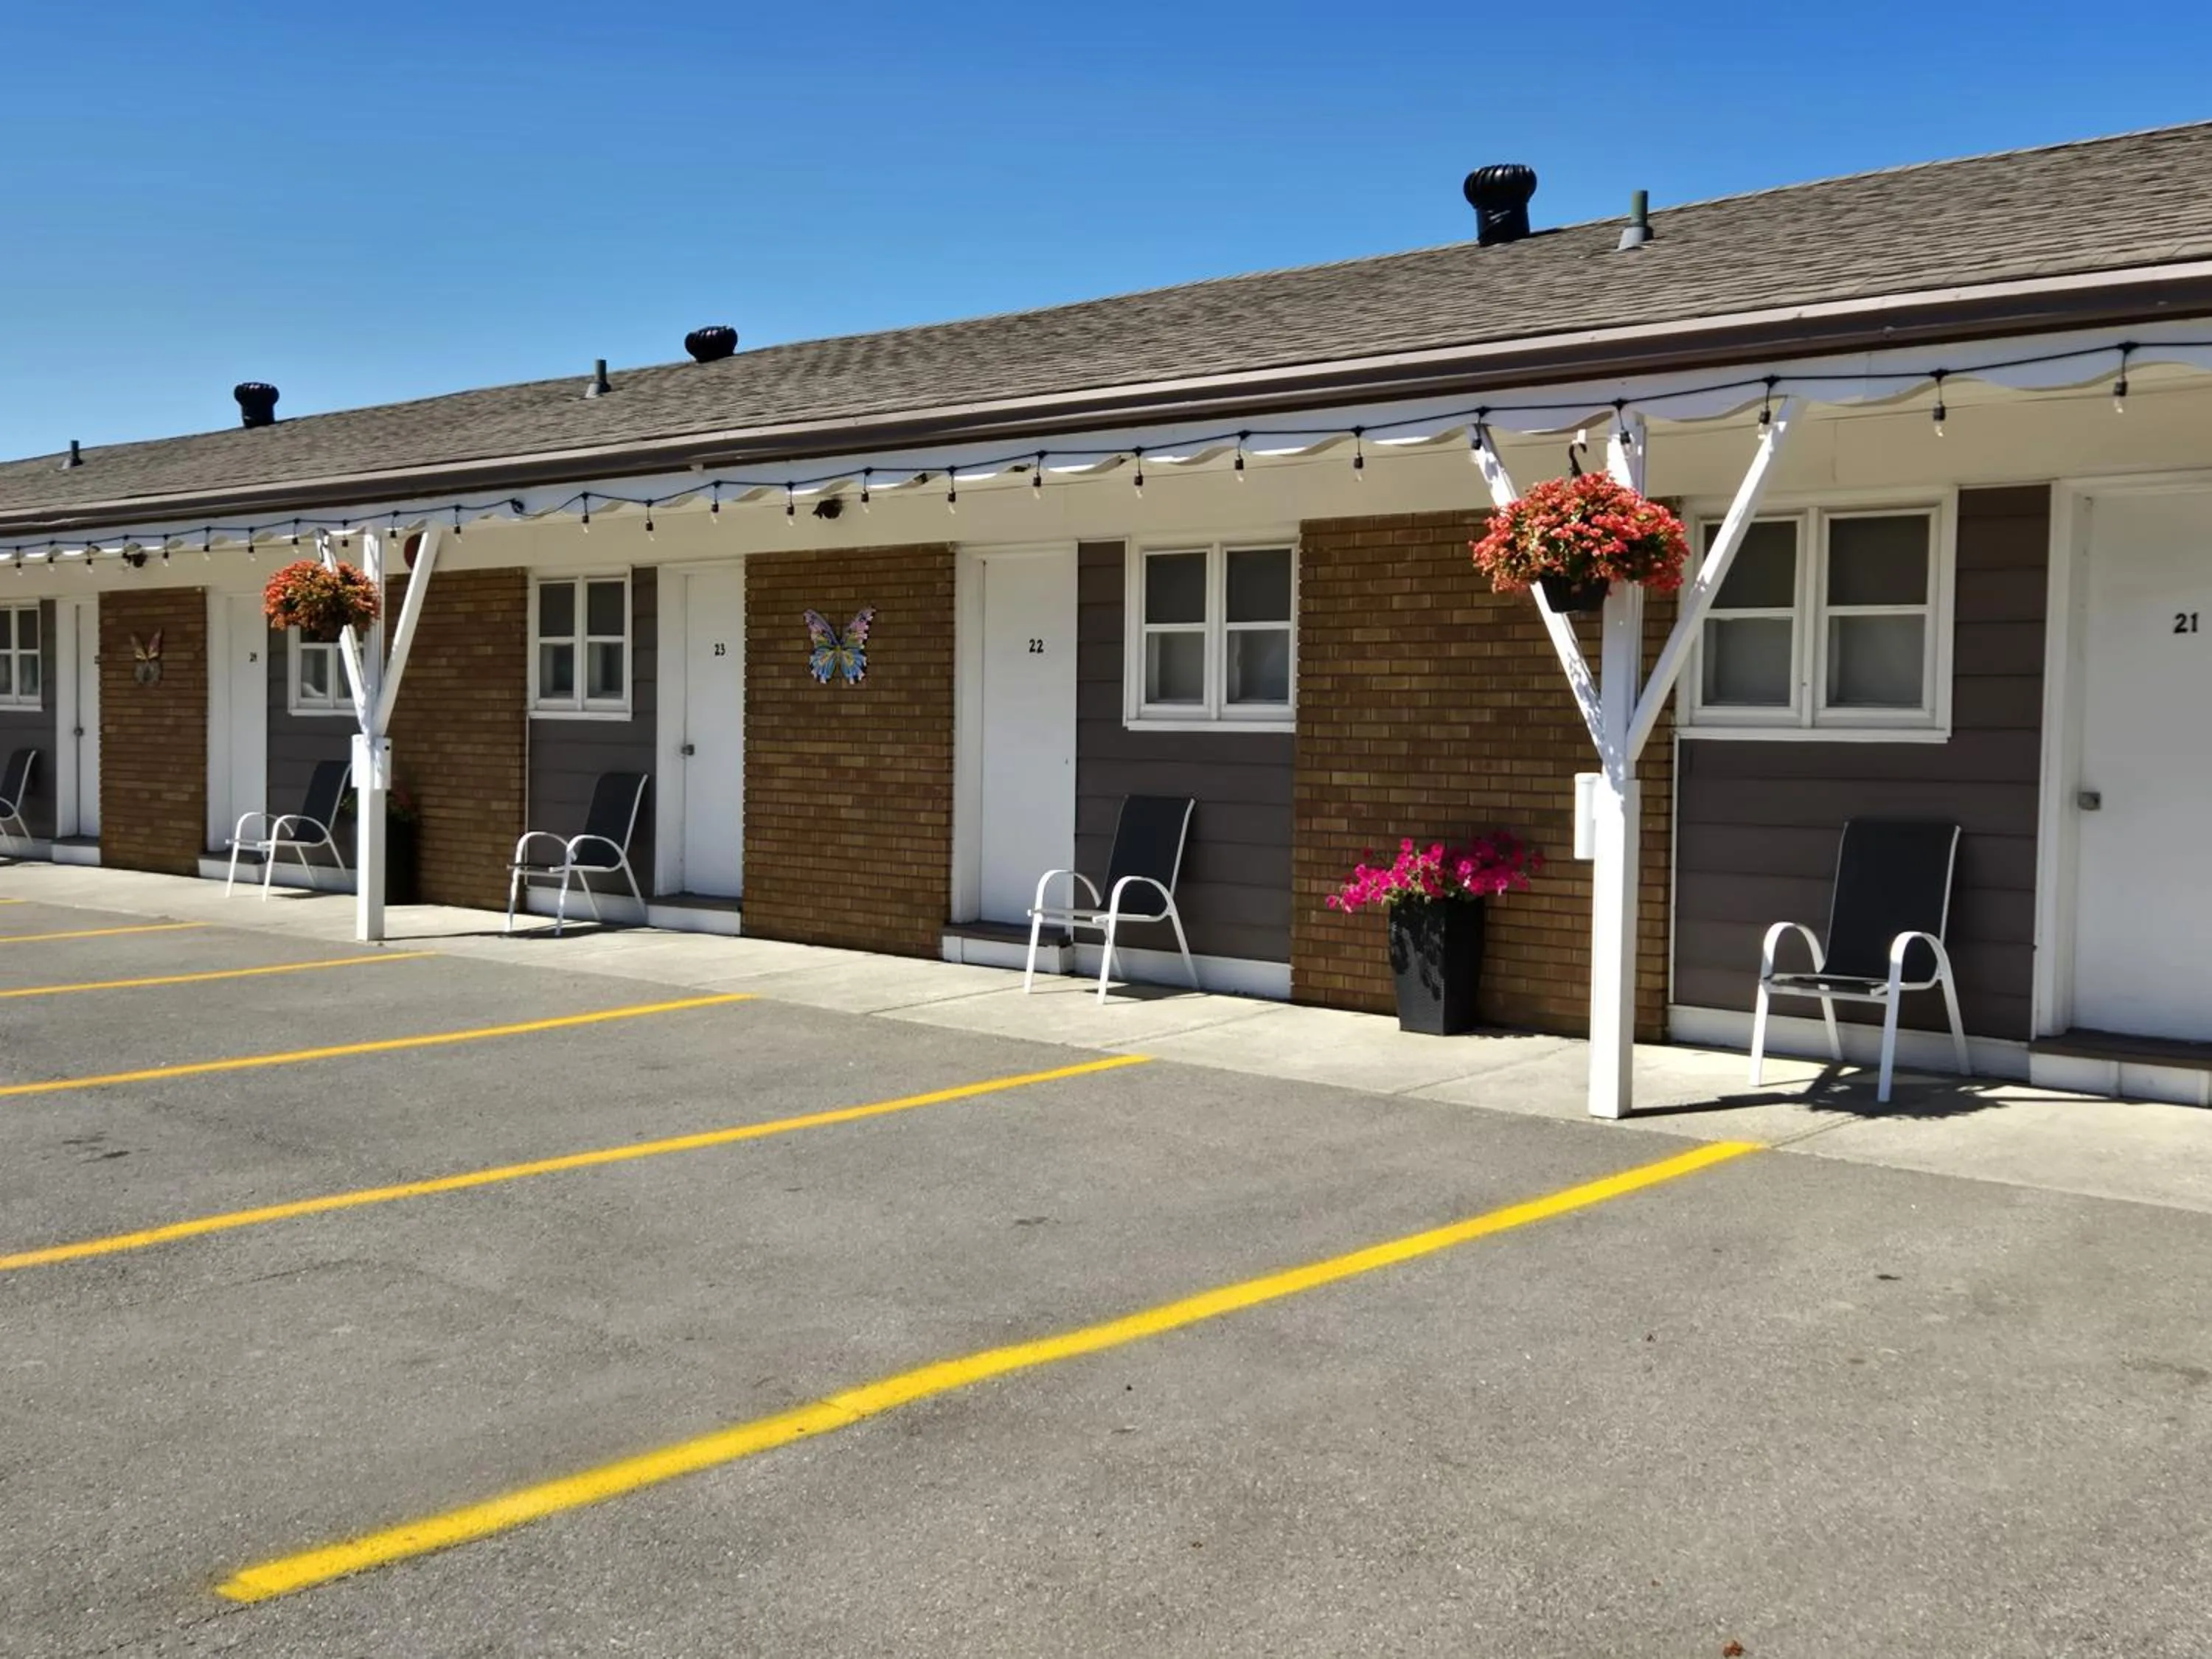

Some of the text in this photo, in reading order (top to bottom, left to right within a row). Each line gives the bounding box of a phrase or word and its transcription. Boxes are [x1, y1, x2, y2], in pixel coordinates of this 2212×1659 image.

[2174, 612, 2199, 633] 21
[714, 642, 726, 655] 23
[1029, 639, 1043, 653] 22
